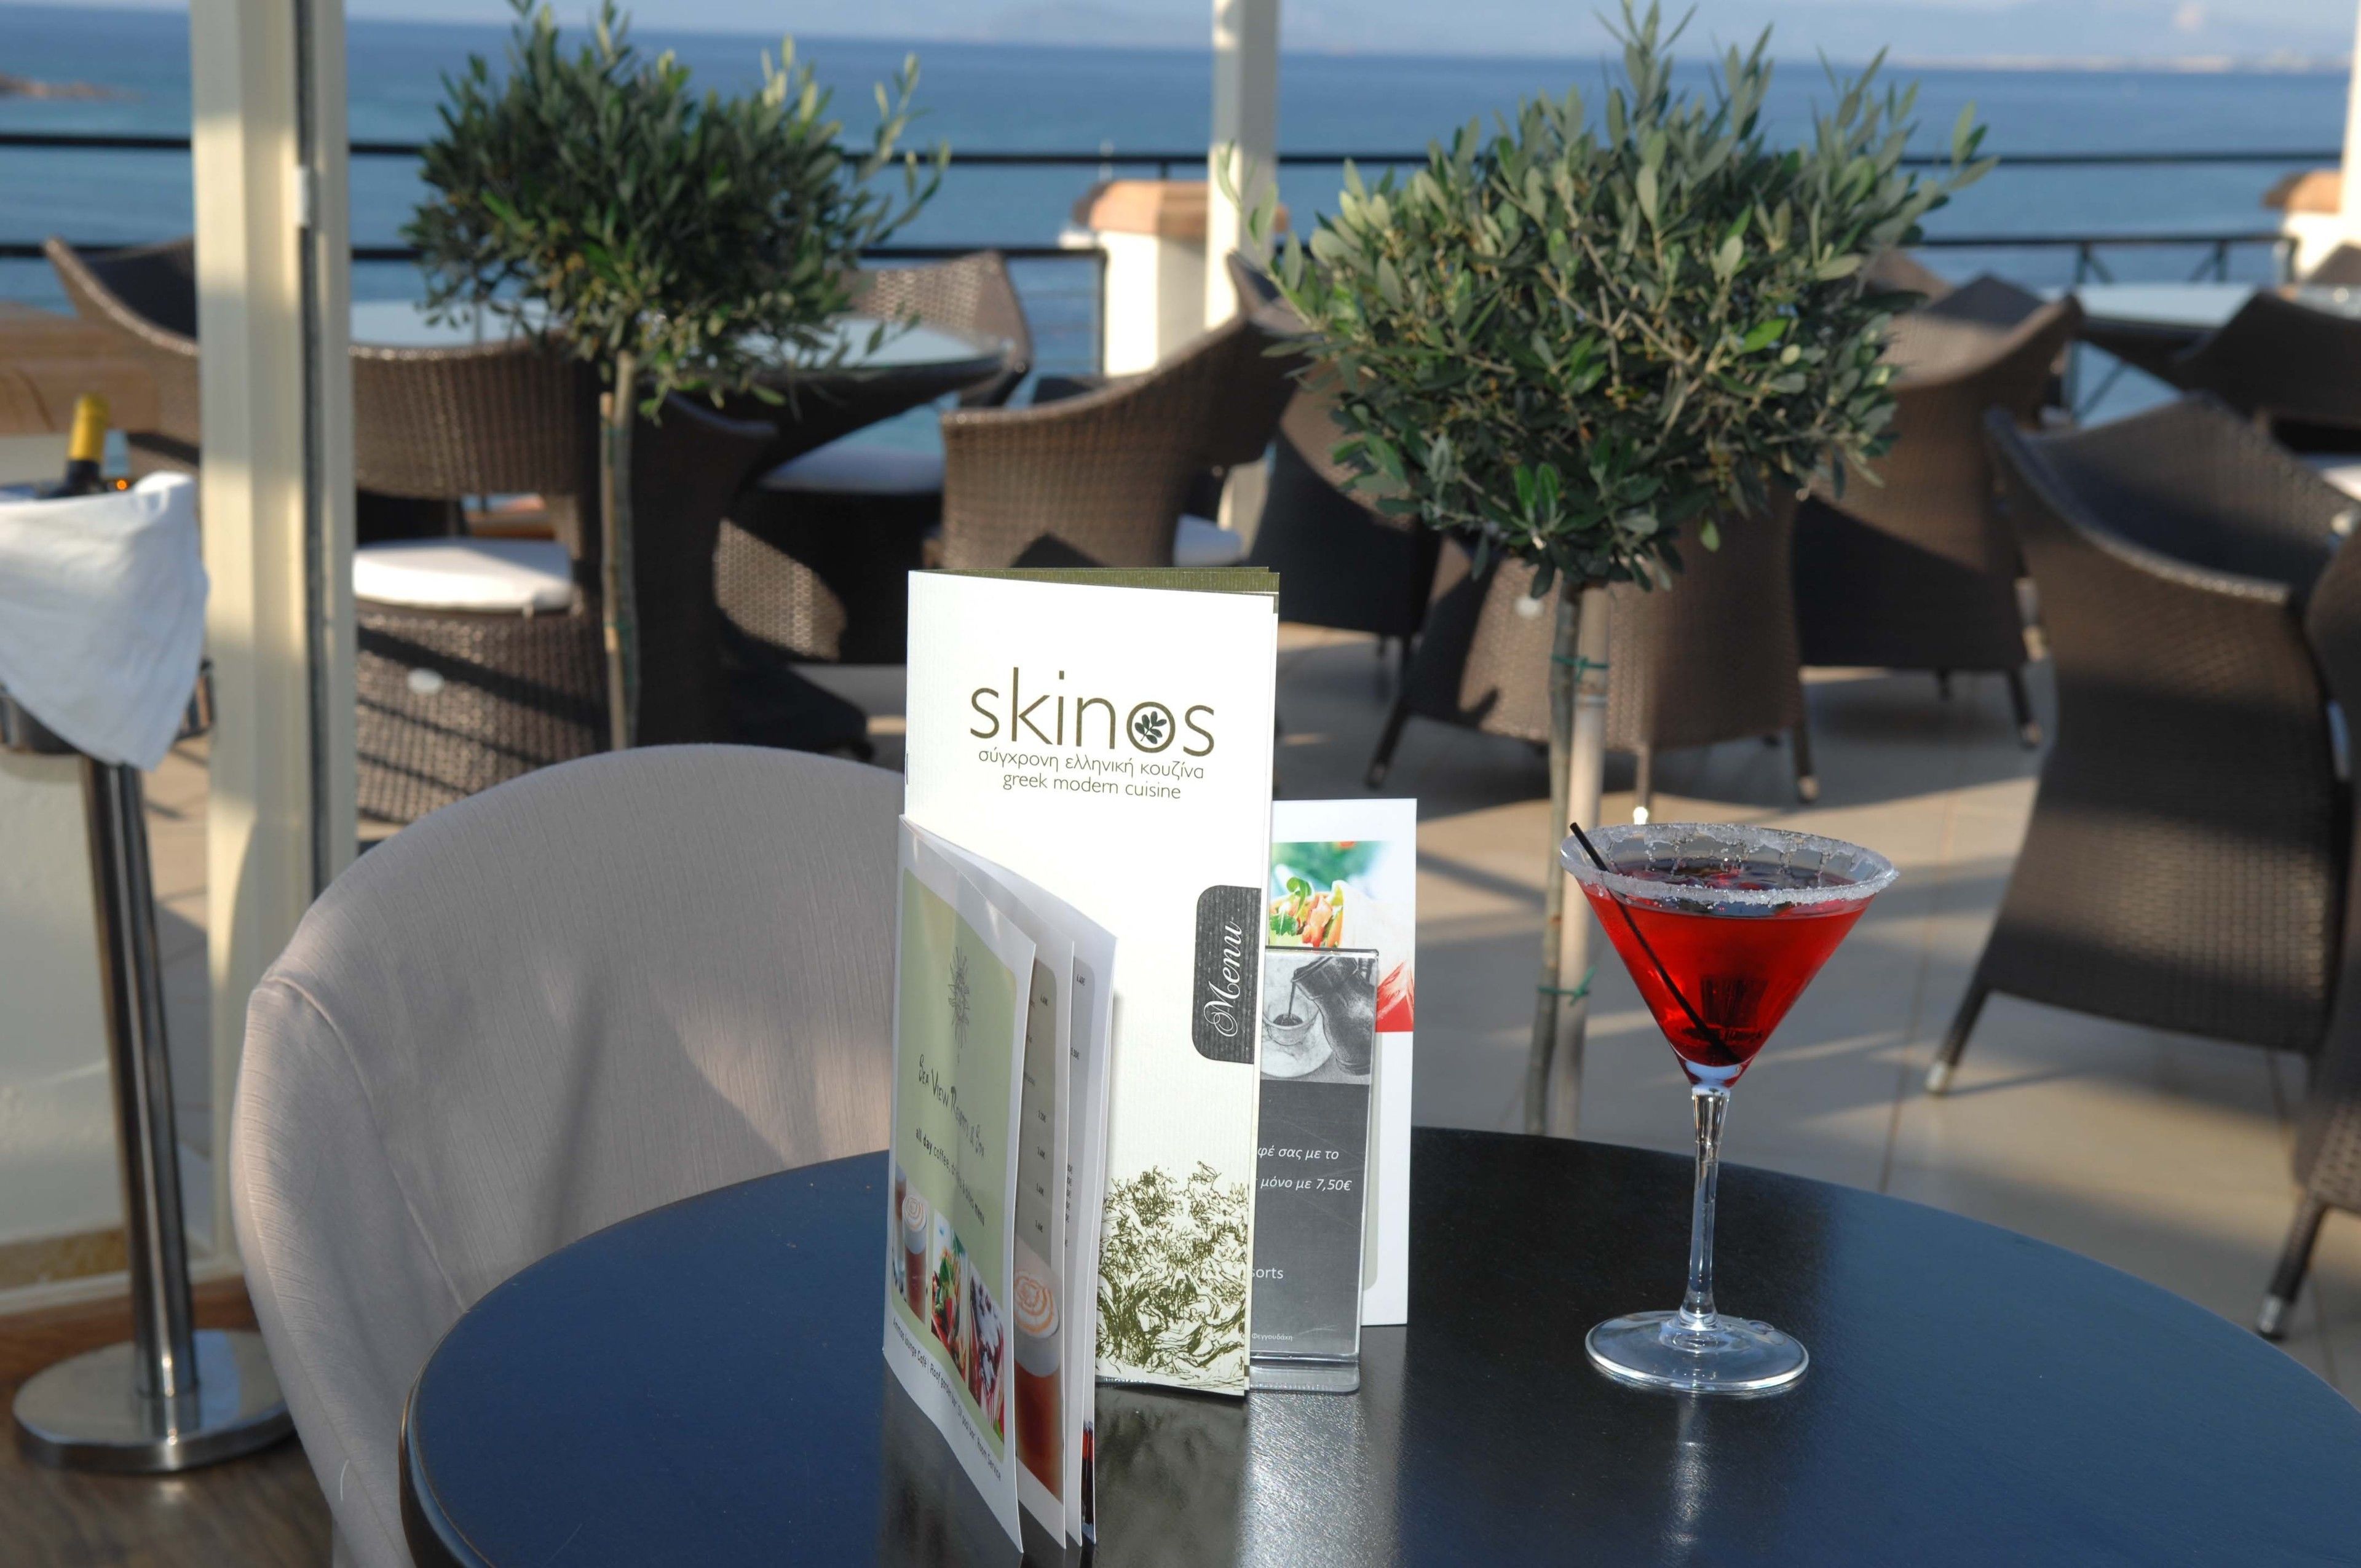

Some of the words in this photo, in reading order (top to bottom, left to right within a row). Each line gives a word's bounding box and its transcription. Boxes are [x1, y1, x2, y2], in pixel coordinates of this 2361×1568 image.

[970, 667, 1215, 757] skinos
[978, 746, 1059, 772] σύγχρονη
[1065, 754, 1134, 778] ελληνική
[1140, 760, 1204, 781] κουζίνα
[1003, 773, 1048, 791] greek
[1053, 777, 1118, 794] modern
[1125, 781, 1181, 799] cuisine
[1203, 919, 1243, 1037] Menu
[923, 1134, 933, 1155] day
[1278, 1148, 1303, 1160] σας
[1305, 1149, 1322, 1161] με
[1325, 1150, 1339, 1160] το
[1260, 1176, 1293, 1189] μόνο
[1295, 1179, 1313, 1191] με
[1315, 1178, 1353, 1192] 7,50€
[917, 1350, 927, 1368] Café
[930, 1363, 941, 1384] Roof
